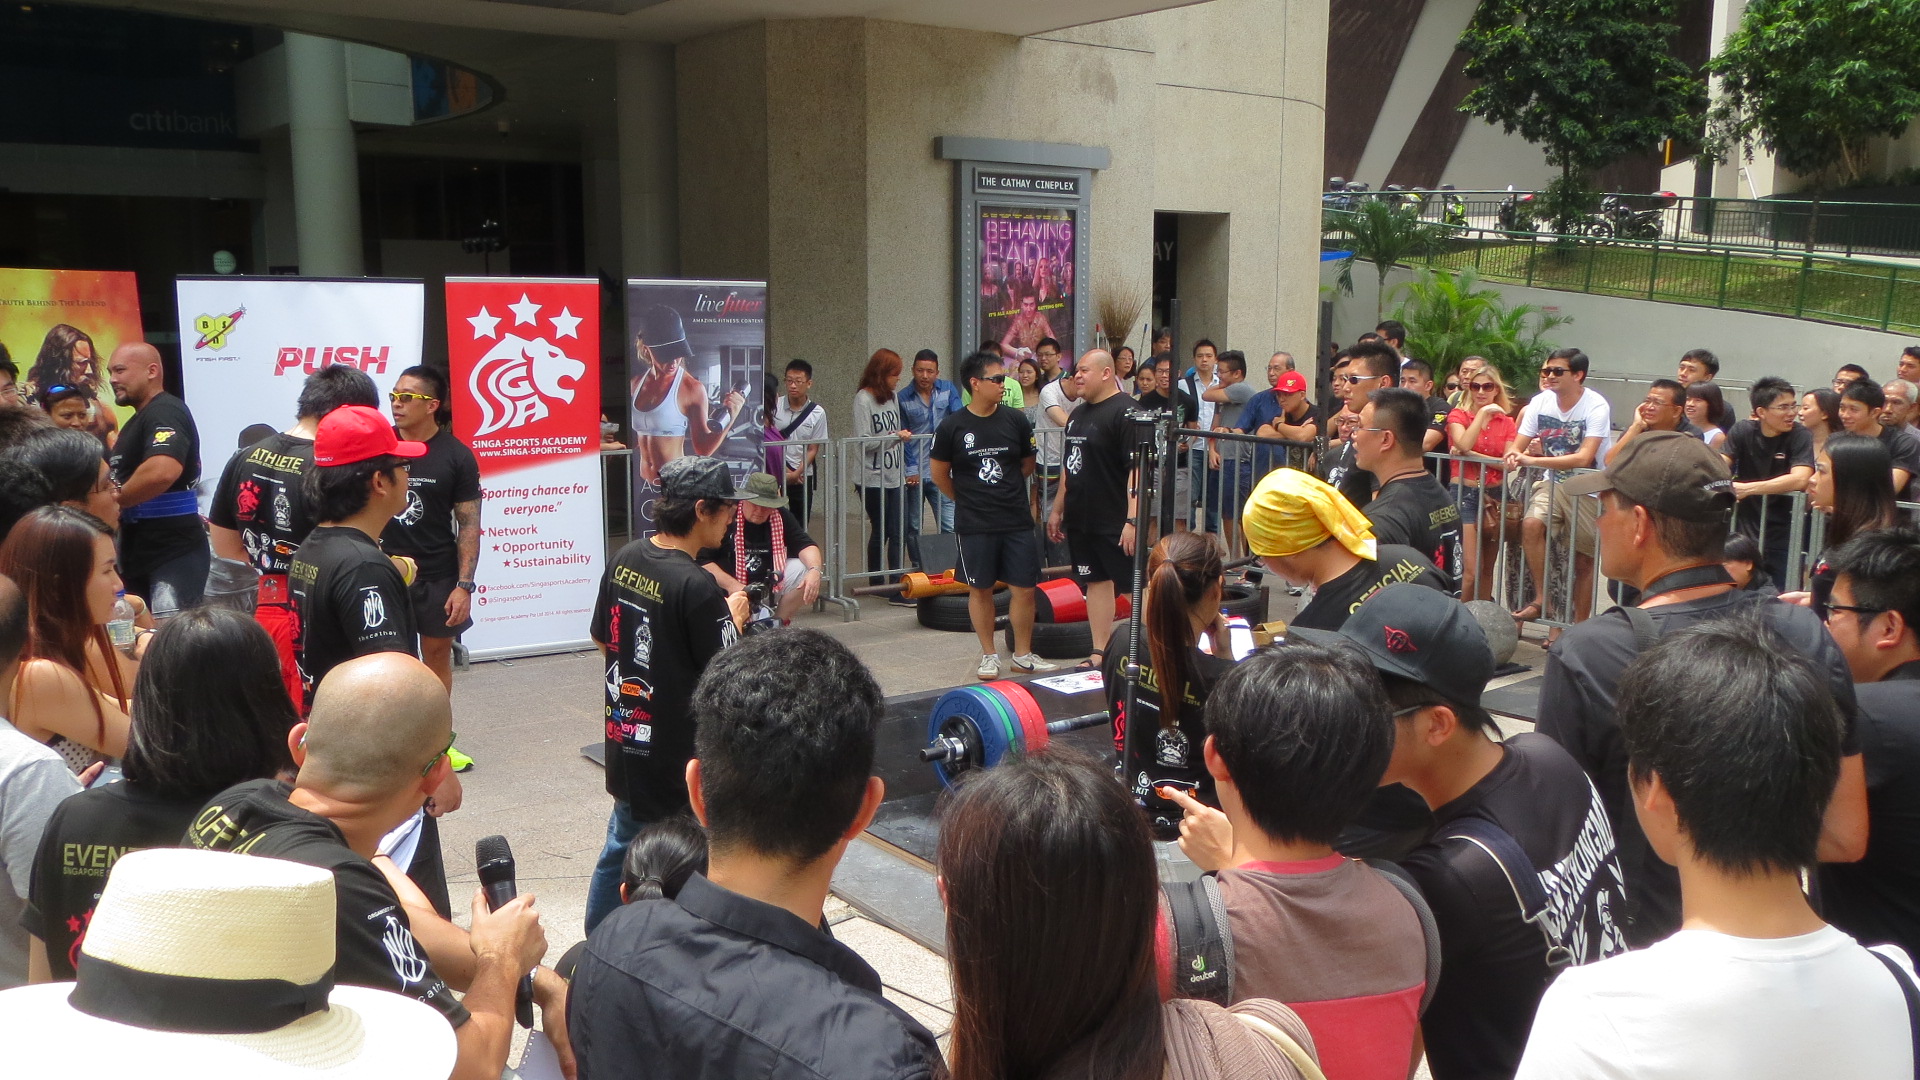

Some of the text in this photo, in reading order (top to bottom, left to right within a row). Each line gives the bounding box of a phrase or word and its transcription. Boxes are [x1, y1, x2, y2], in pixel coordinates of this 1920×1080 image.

[129, 109, 233, 134] citibank
[981, 176, 1074, 191] THE CATHAY CINEPLEX
[986, 220, 1071, 241] BEHAVING
[987, 241, 1070, 268] BADLY
[1153, 241, 1174, 261] AY
[27, 299, 57, 307] BEHIND
[76, 300, 107, 308] LEGEND
[694, 293, 763, 317] livefitter
[1006, 308, 1021, 316] ABOUT
[274, 345, 390, 377] PUSH
[472, 436, 588, 449] SINGA-SPORTS ACADEMY
[251, 447, 305, 470] ATHLETE
[480, 446, 582, 457] www.SINGA-SPORTS.com
[531, 484, 570, 497] chance
[572, 483, 589, 494] for
[488, 524, 538, 538] Network
[502, 539, 575, 554] Opportunity
[513, 553, 592, 568] Sustainability
[614, 565, 662, 598] OFFICIAL
[622, 684, 641, 695] HOME
[1135, 786, 1150, 796] KIT
[63, 843, 150, 868] EVEN
[63, 866, 104, 878] SINGAPORE
[1190, 970, 1217, 983] deuter
